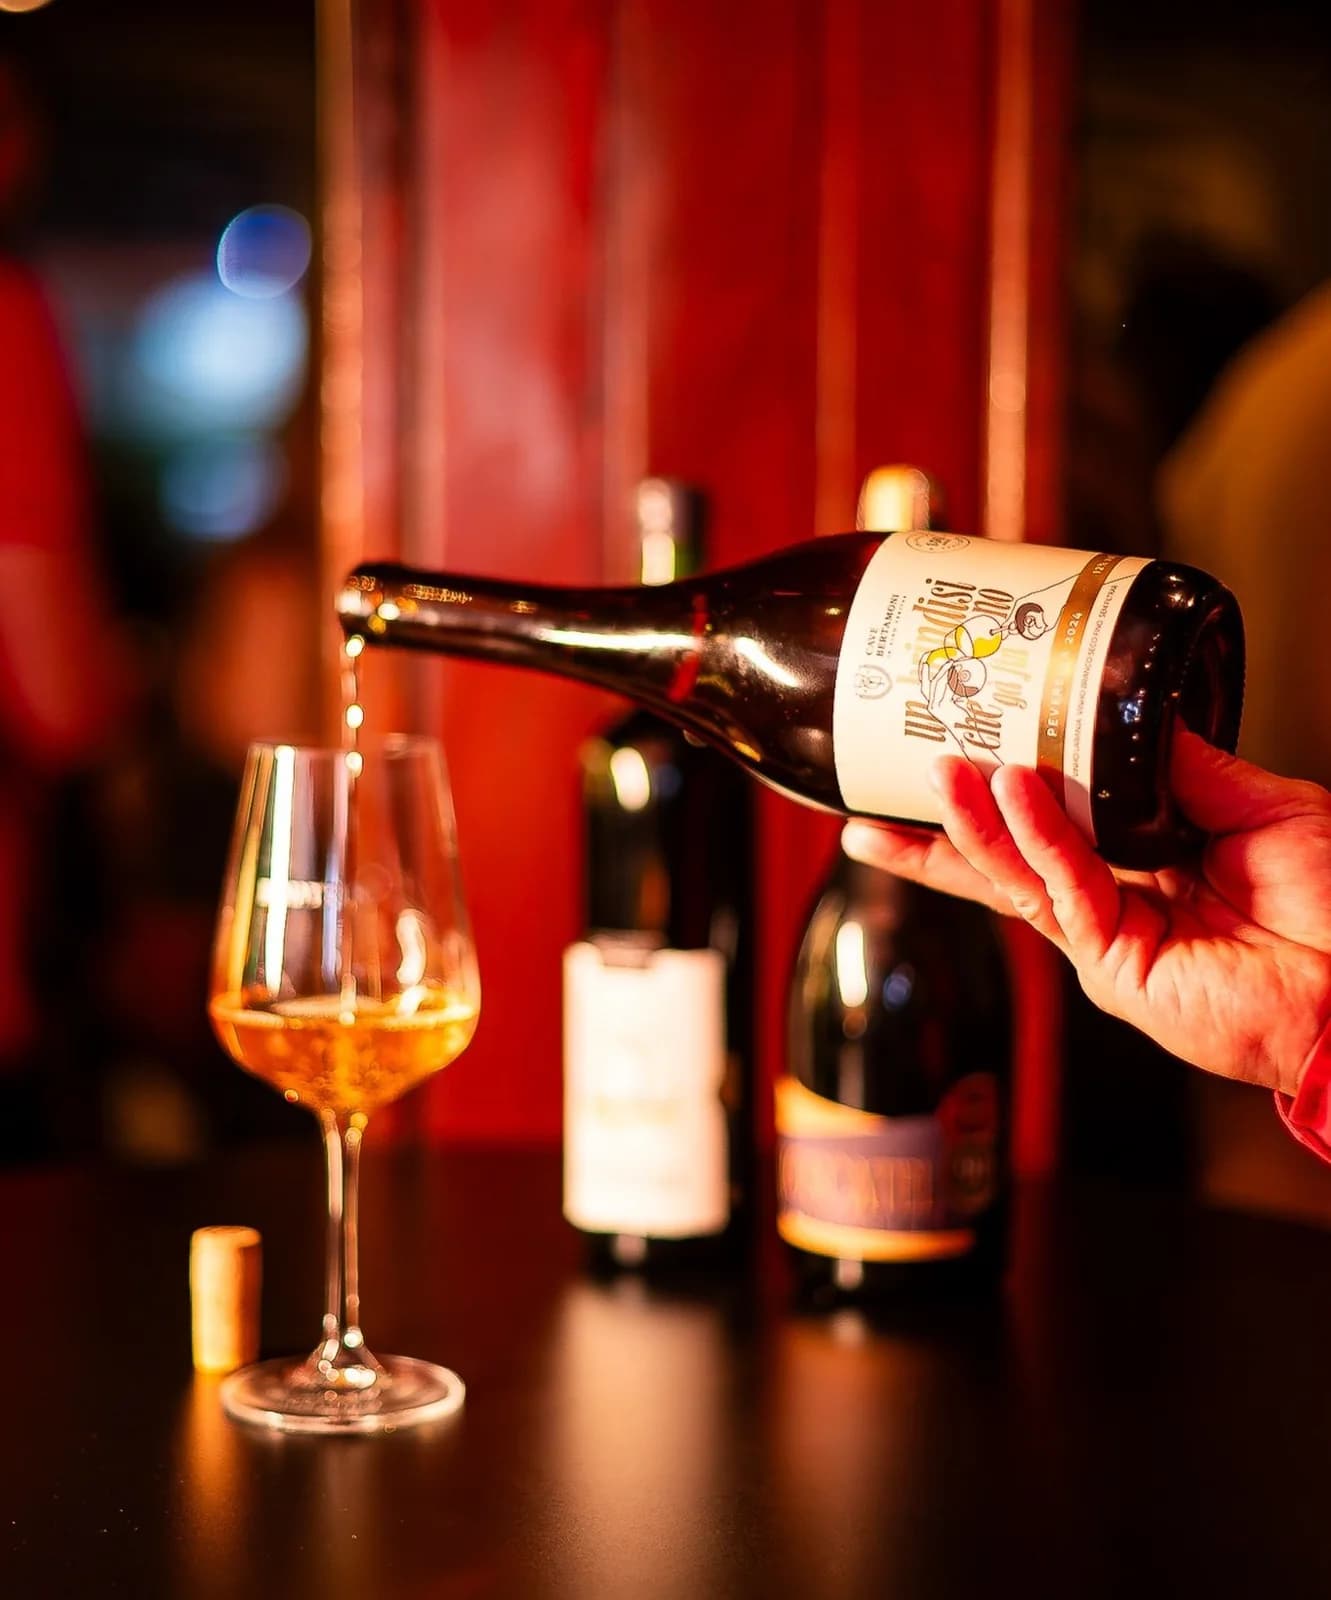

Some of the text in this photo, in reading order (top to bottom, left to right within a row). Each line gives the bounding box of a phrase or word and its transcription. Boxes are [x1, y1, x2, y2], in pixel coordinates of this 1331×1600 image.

[865, 627, 878, 656] CAVE
[876, 594, 900, 657] BERTAMONI
[1065, 612, 1083, 644] 2024
[1088, 636, 1098, 656] SECO
[953, 588, 1015, 750] che no
[904, 700, 947, 743] un
